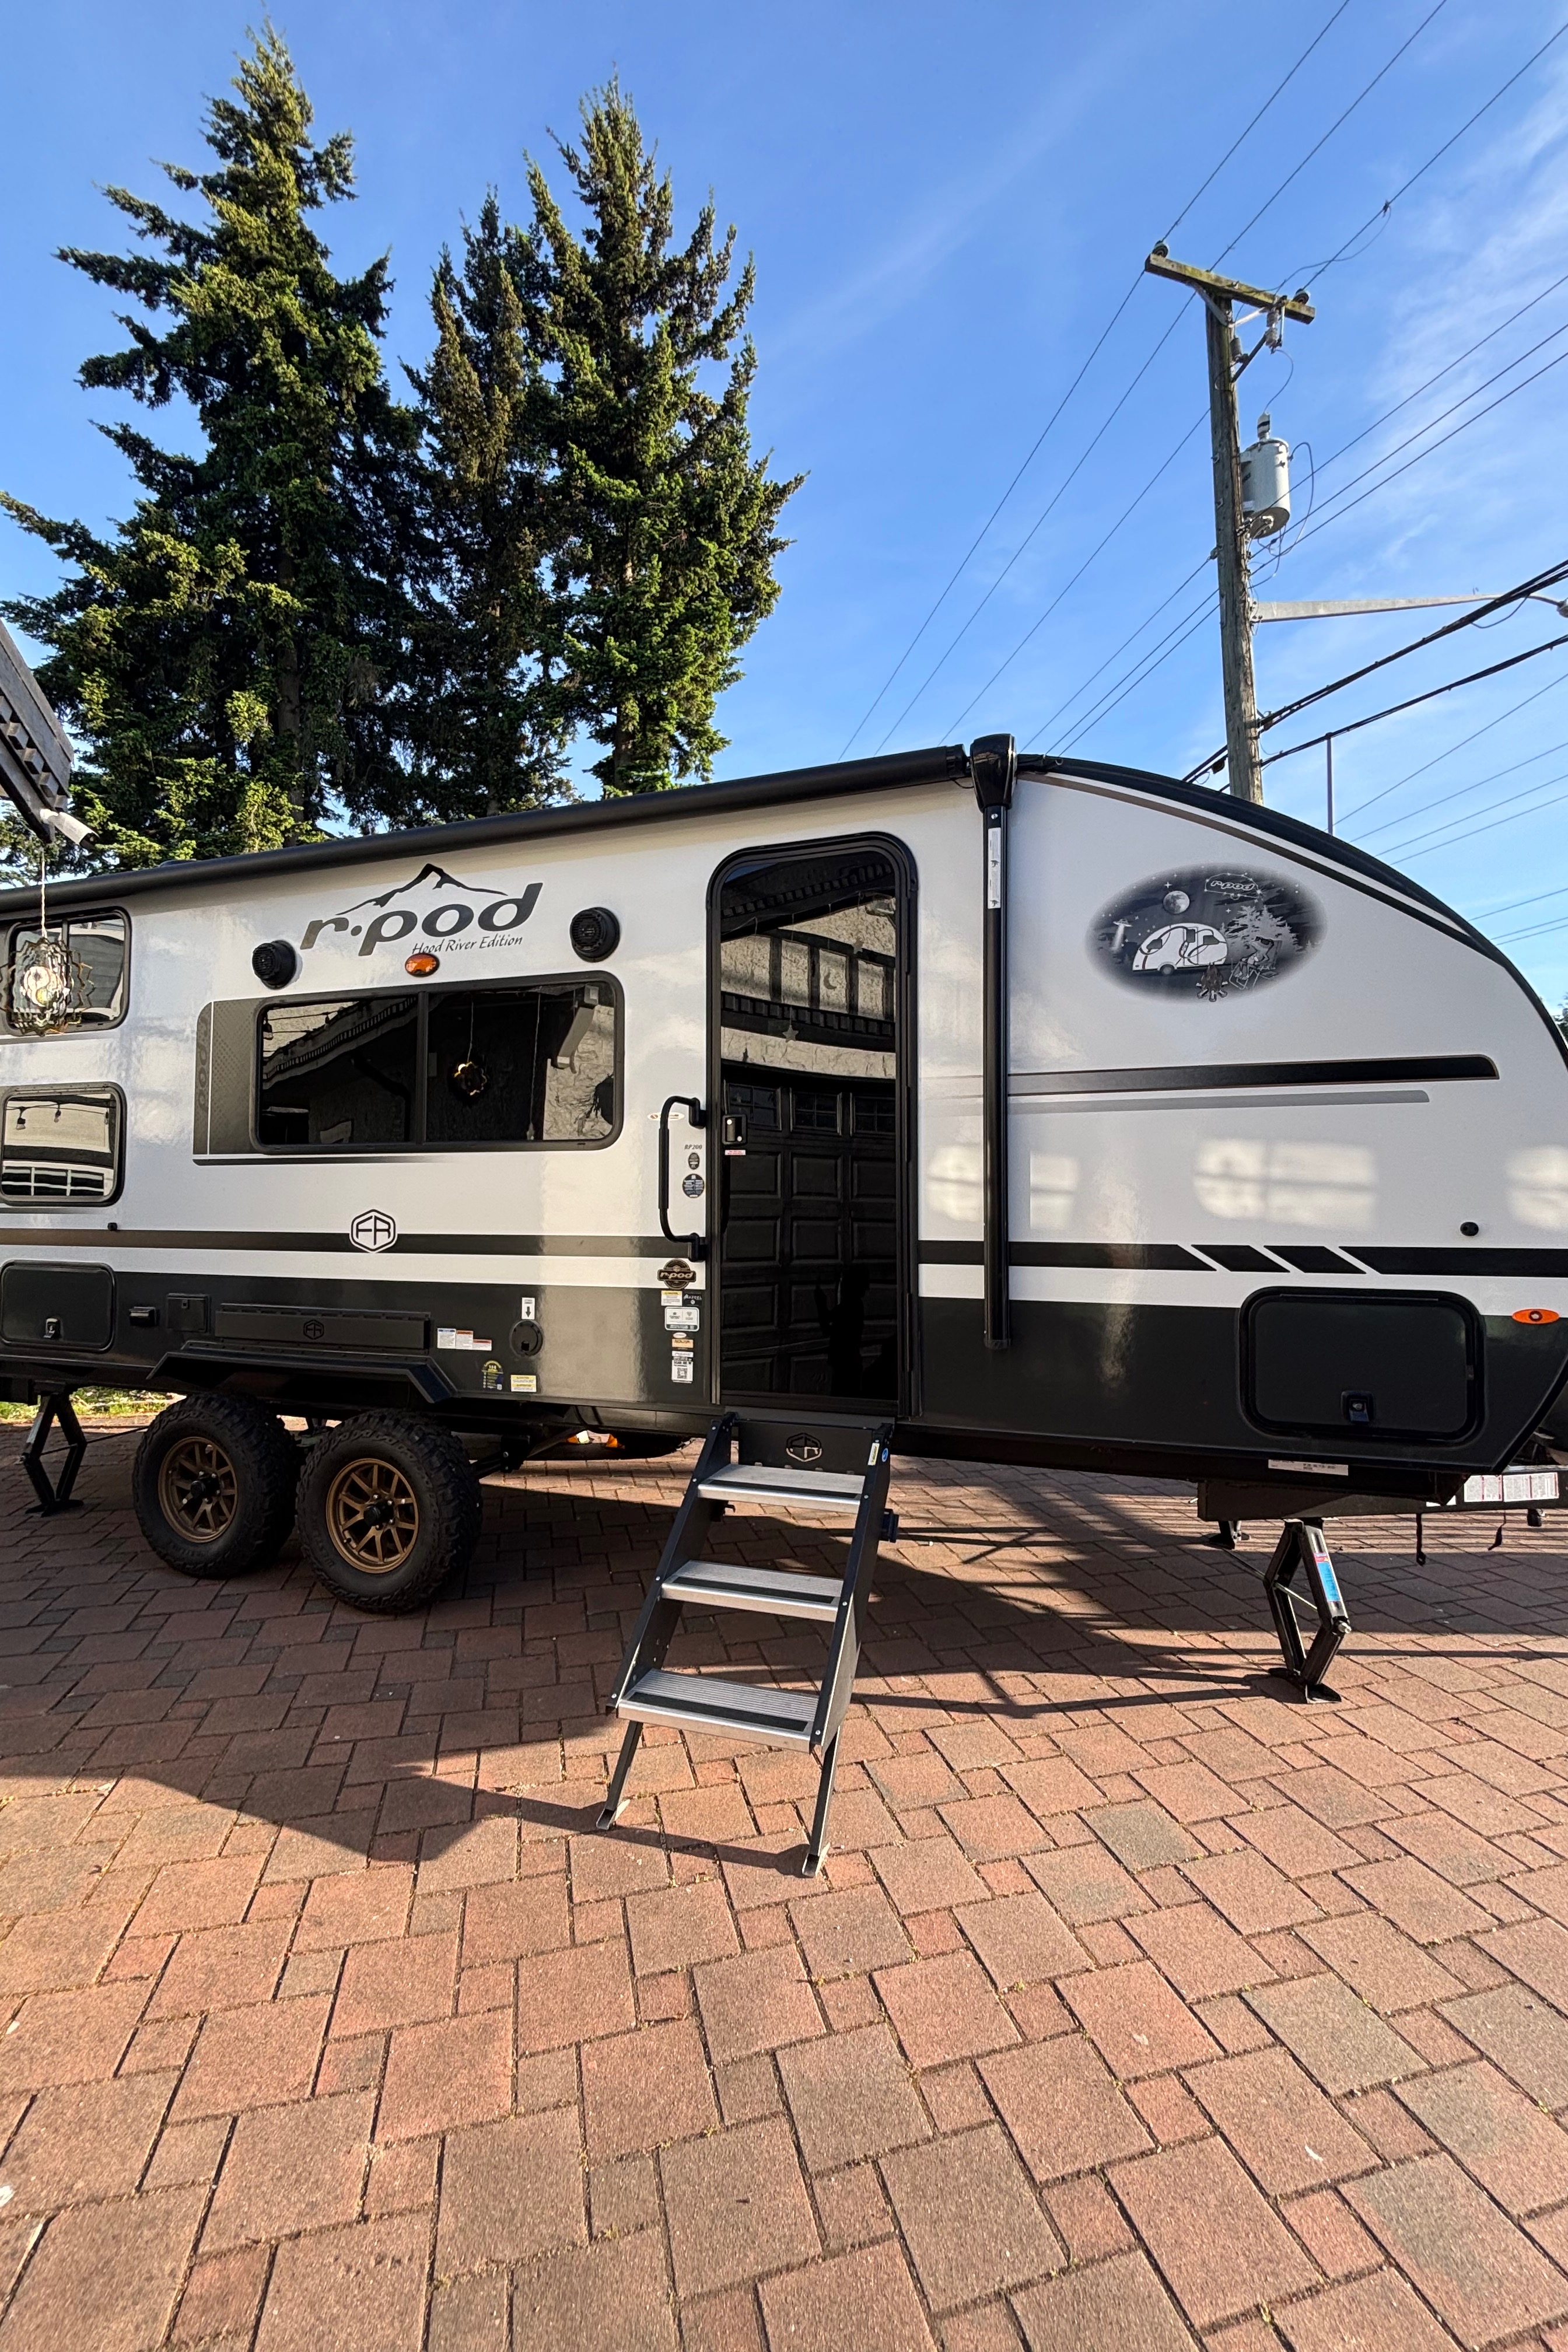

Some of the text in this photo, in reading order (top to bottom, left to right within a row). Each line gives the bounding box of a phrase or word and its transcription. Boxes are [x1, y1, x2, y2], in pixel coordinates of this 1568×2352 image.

[412, 933, 523, 954] Hood River Edition
[356, 1214, 391, 1246] FR
